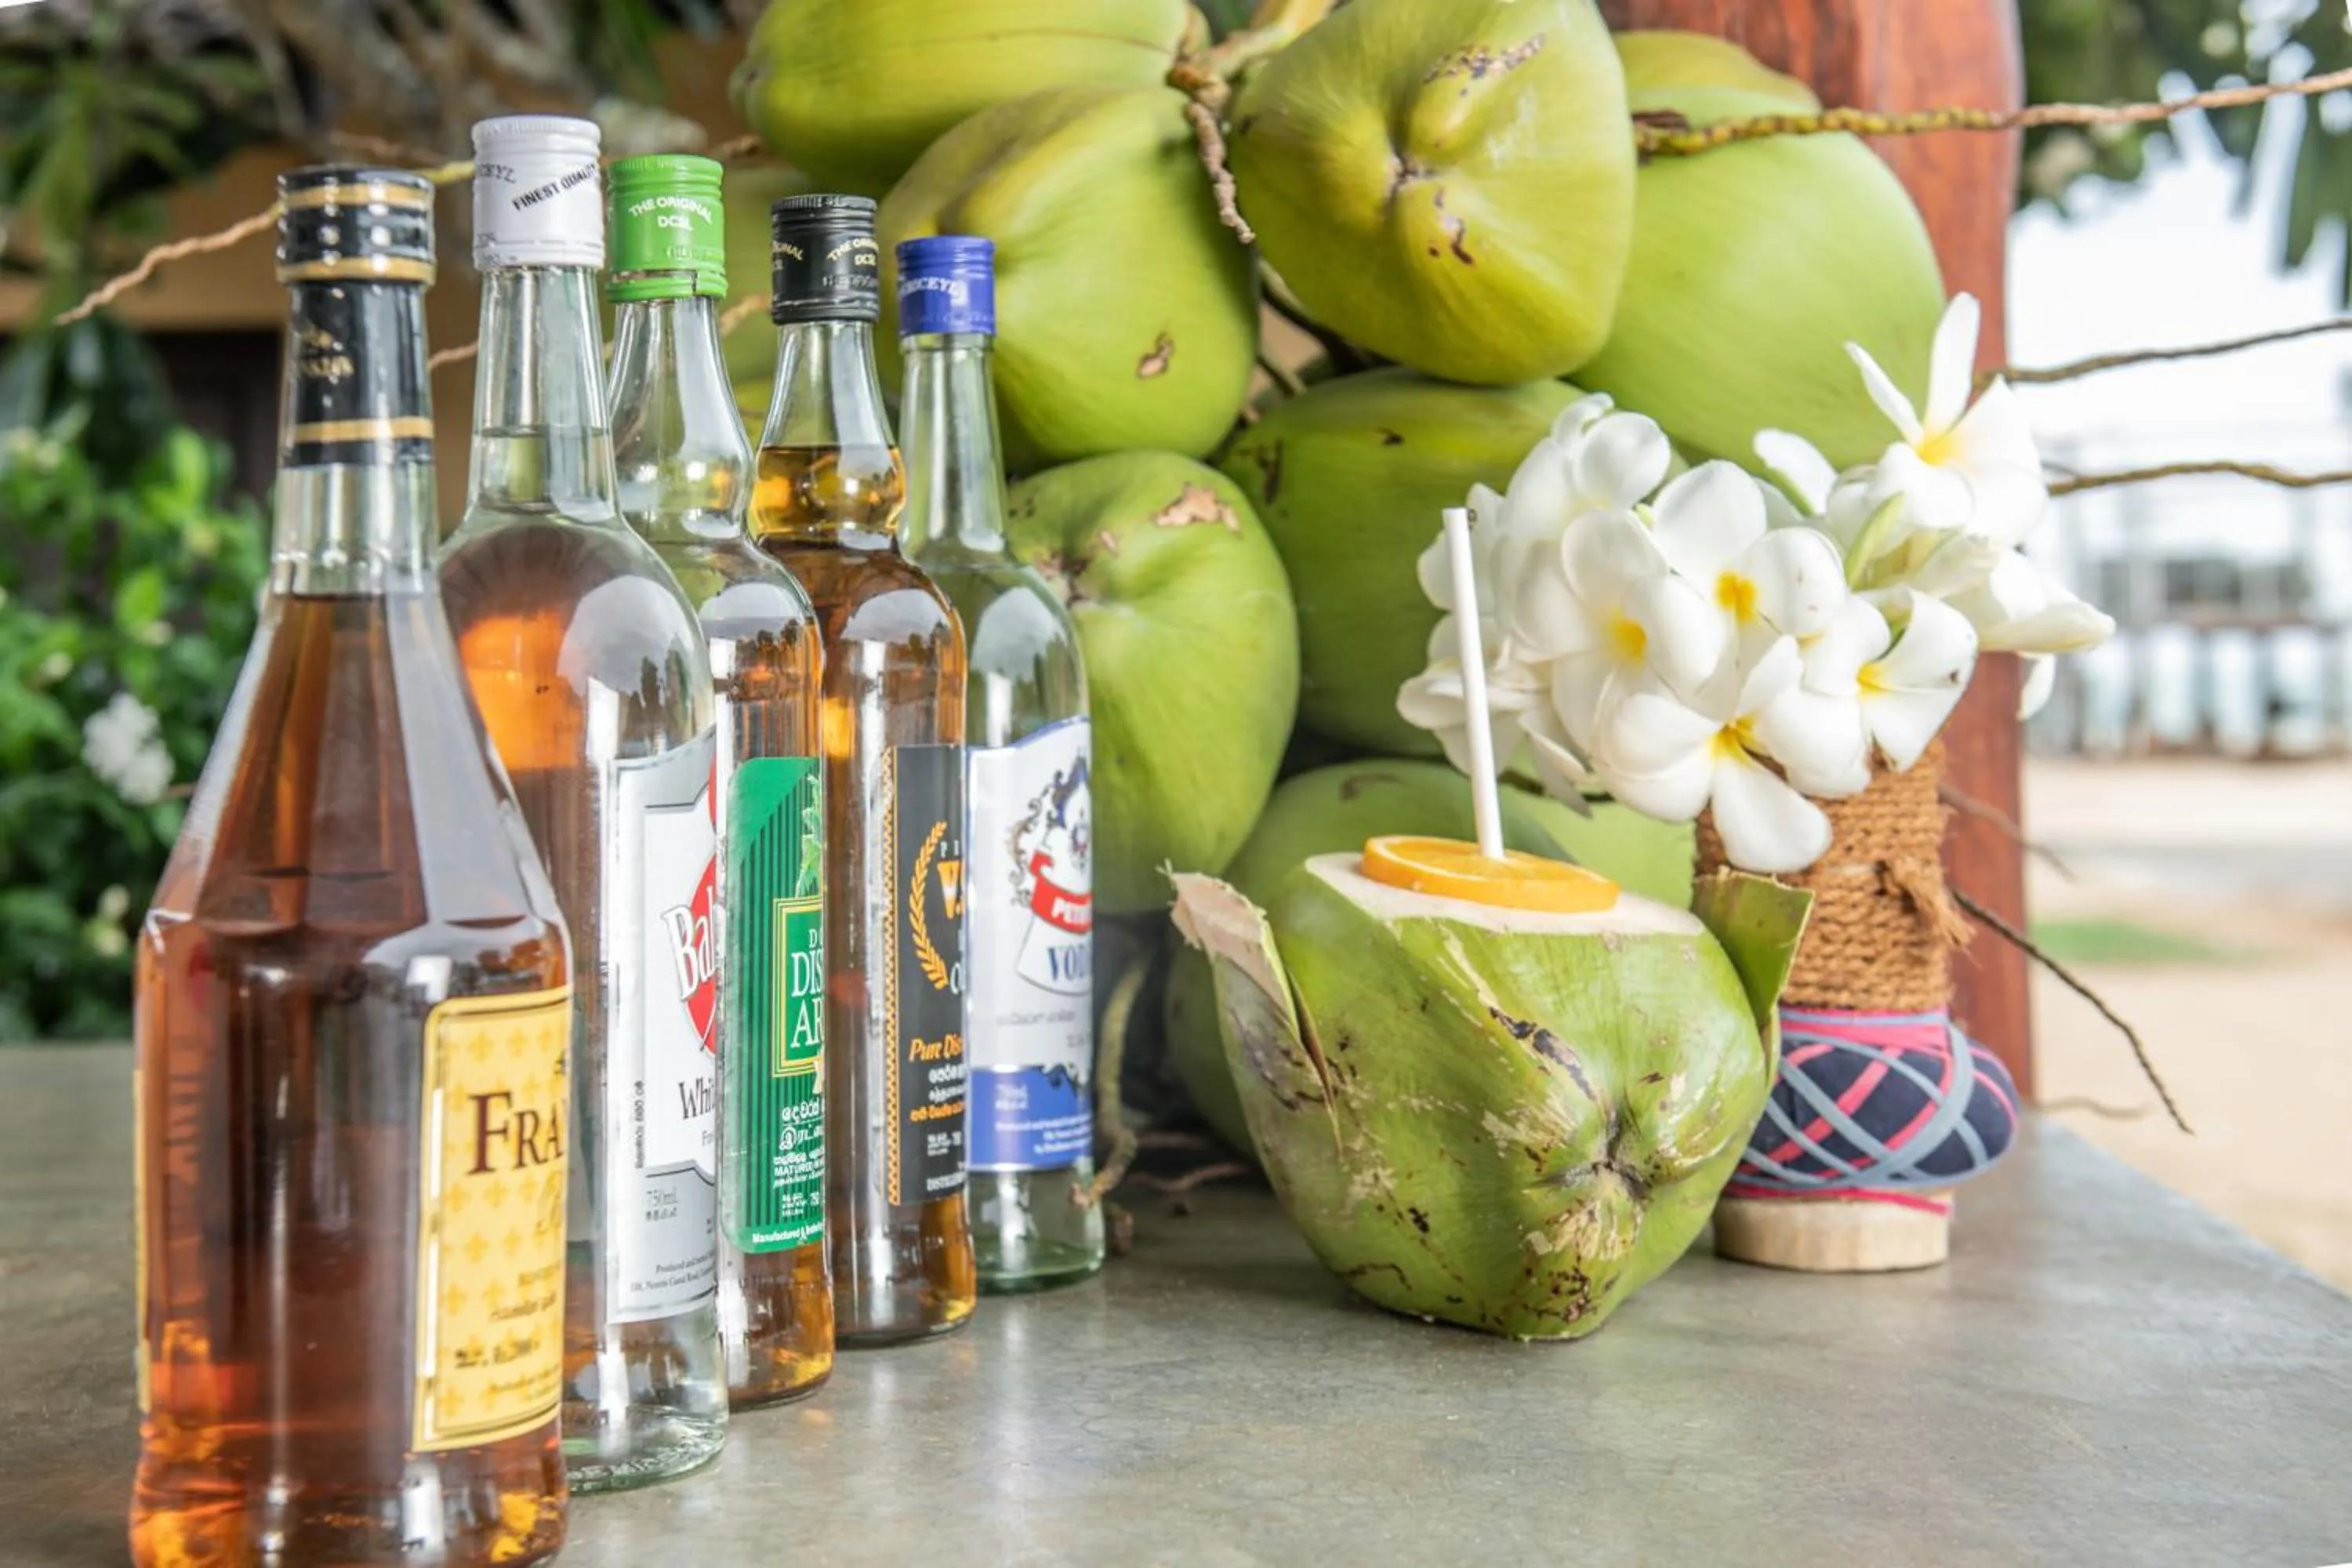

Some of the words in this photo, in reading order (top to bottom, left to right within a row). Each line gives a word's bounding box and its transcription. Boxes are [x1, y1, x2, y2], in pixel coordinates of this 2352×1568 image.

[511, 182, 561, 212] FINEST
[629, 198, 655, 217] THE
[656, 196, 713, 225] ORIGINAL
[826, 240, 853, 261] THE
[791, 949, 824, 998] DIS
[466, 1089, 564, 1175] FRA
